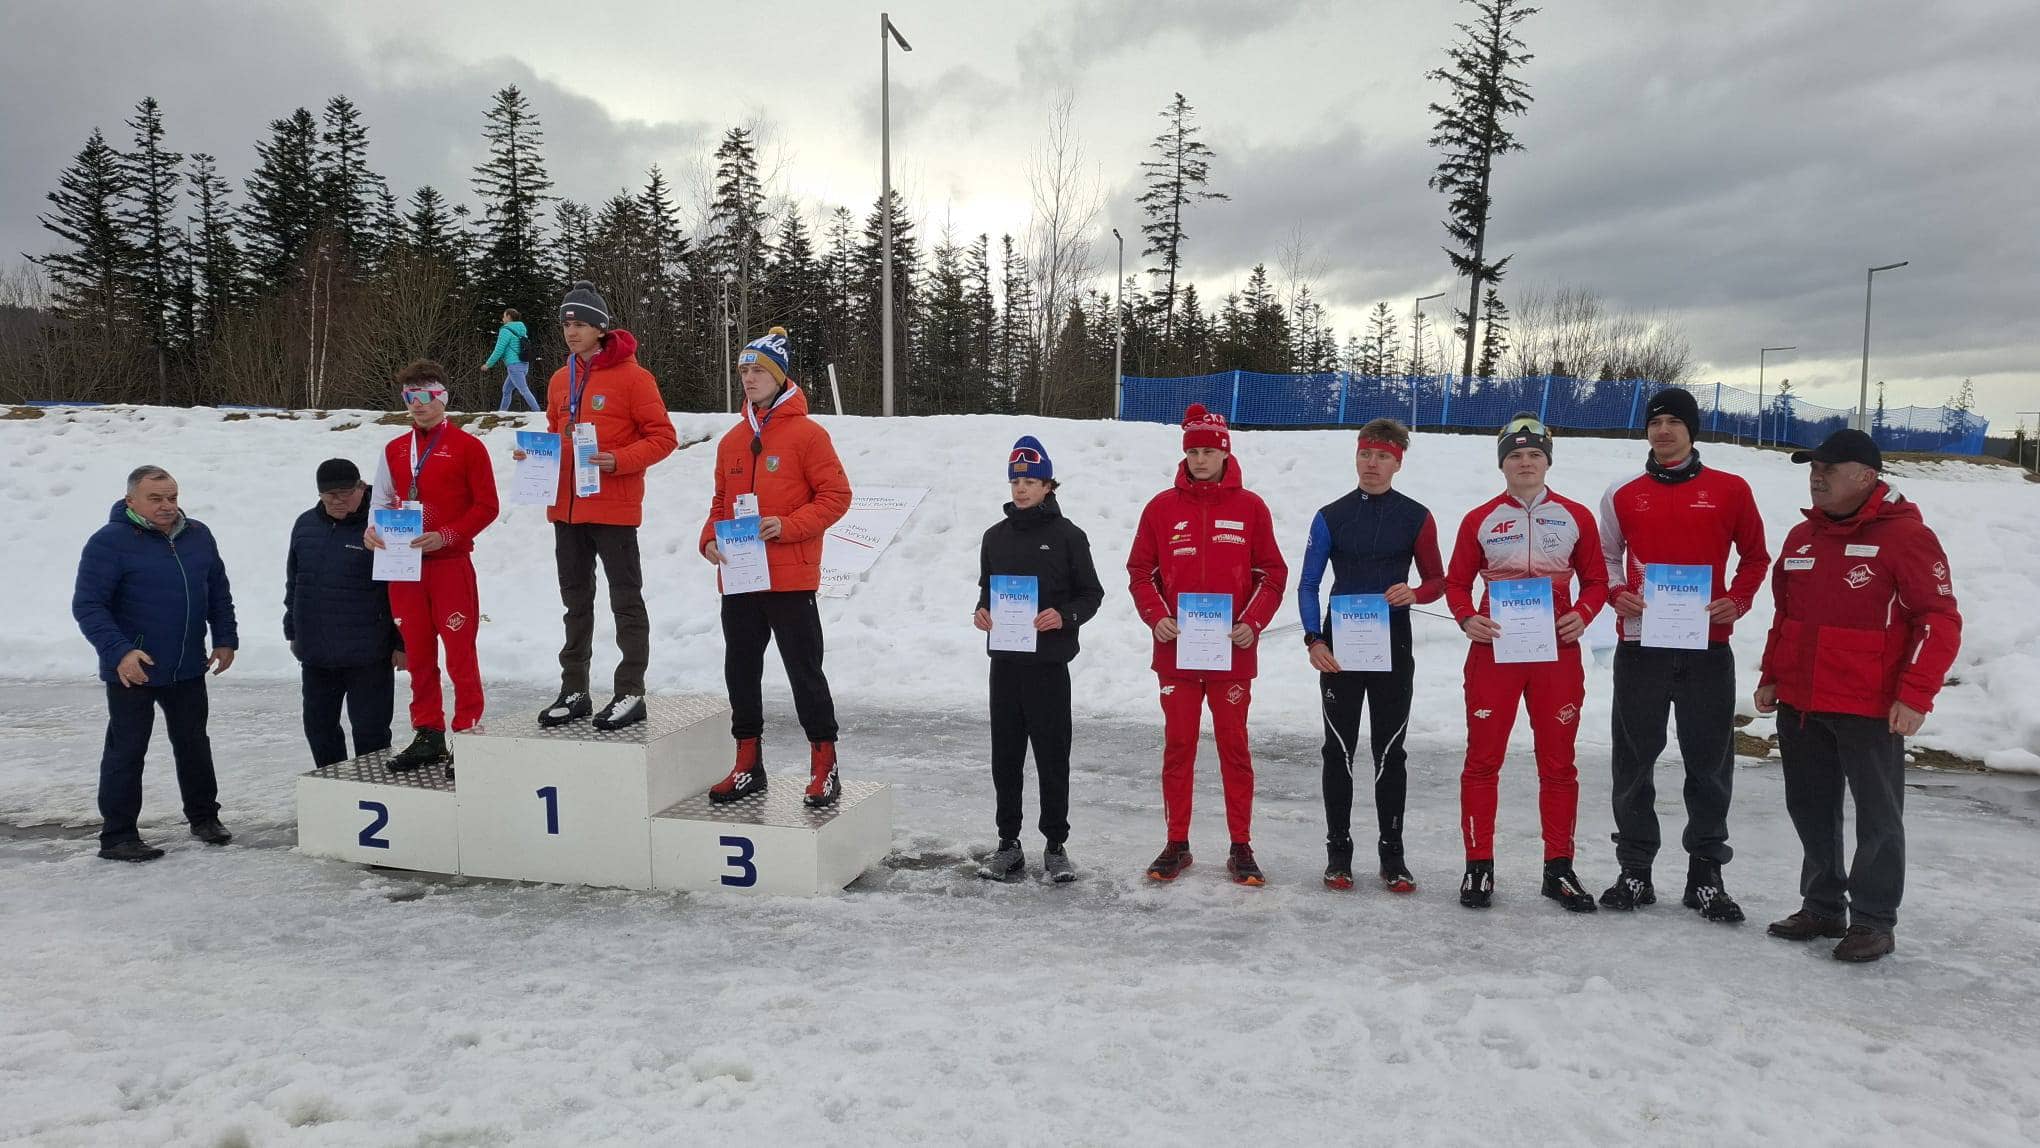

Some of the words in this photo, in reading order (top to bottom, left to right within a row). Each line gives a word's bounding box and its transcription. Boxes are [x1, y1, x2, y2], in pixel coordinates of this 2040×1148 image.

[1491, 520, 1516, 534] 4F
[725, 535, 755, 545] DYPLOM
[1657, 584, 1699, 593] DYPLOM
[1501, 598, 1541, 607] DYPLOM
[1188, 611, 1222, 619] DYPLOM
[1342, 612, 1378, 620] DYPLOM
[536, 786, 559, 835] 1
[358, 800, 390, 849] 2
[719, 836, 757, 888] 3
